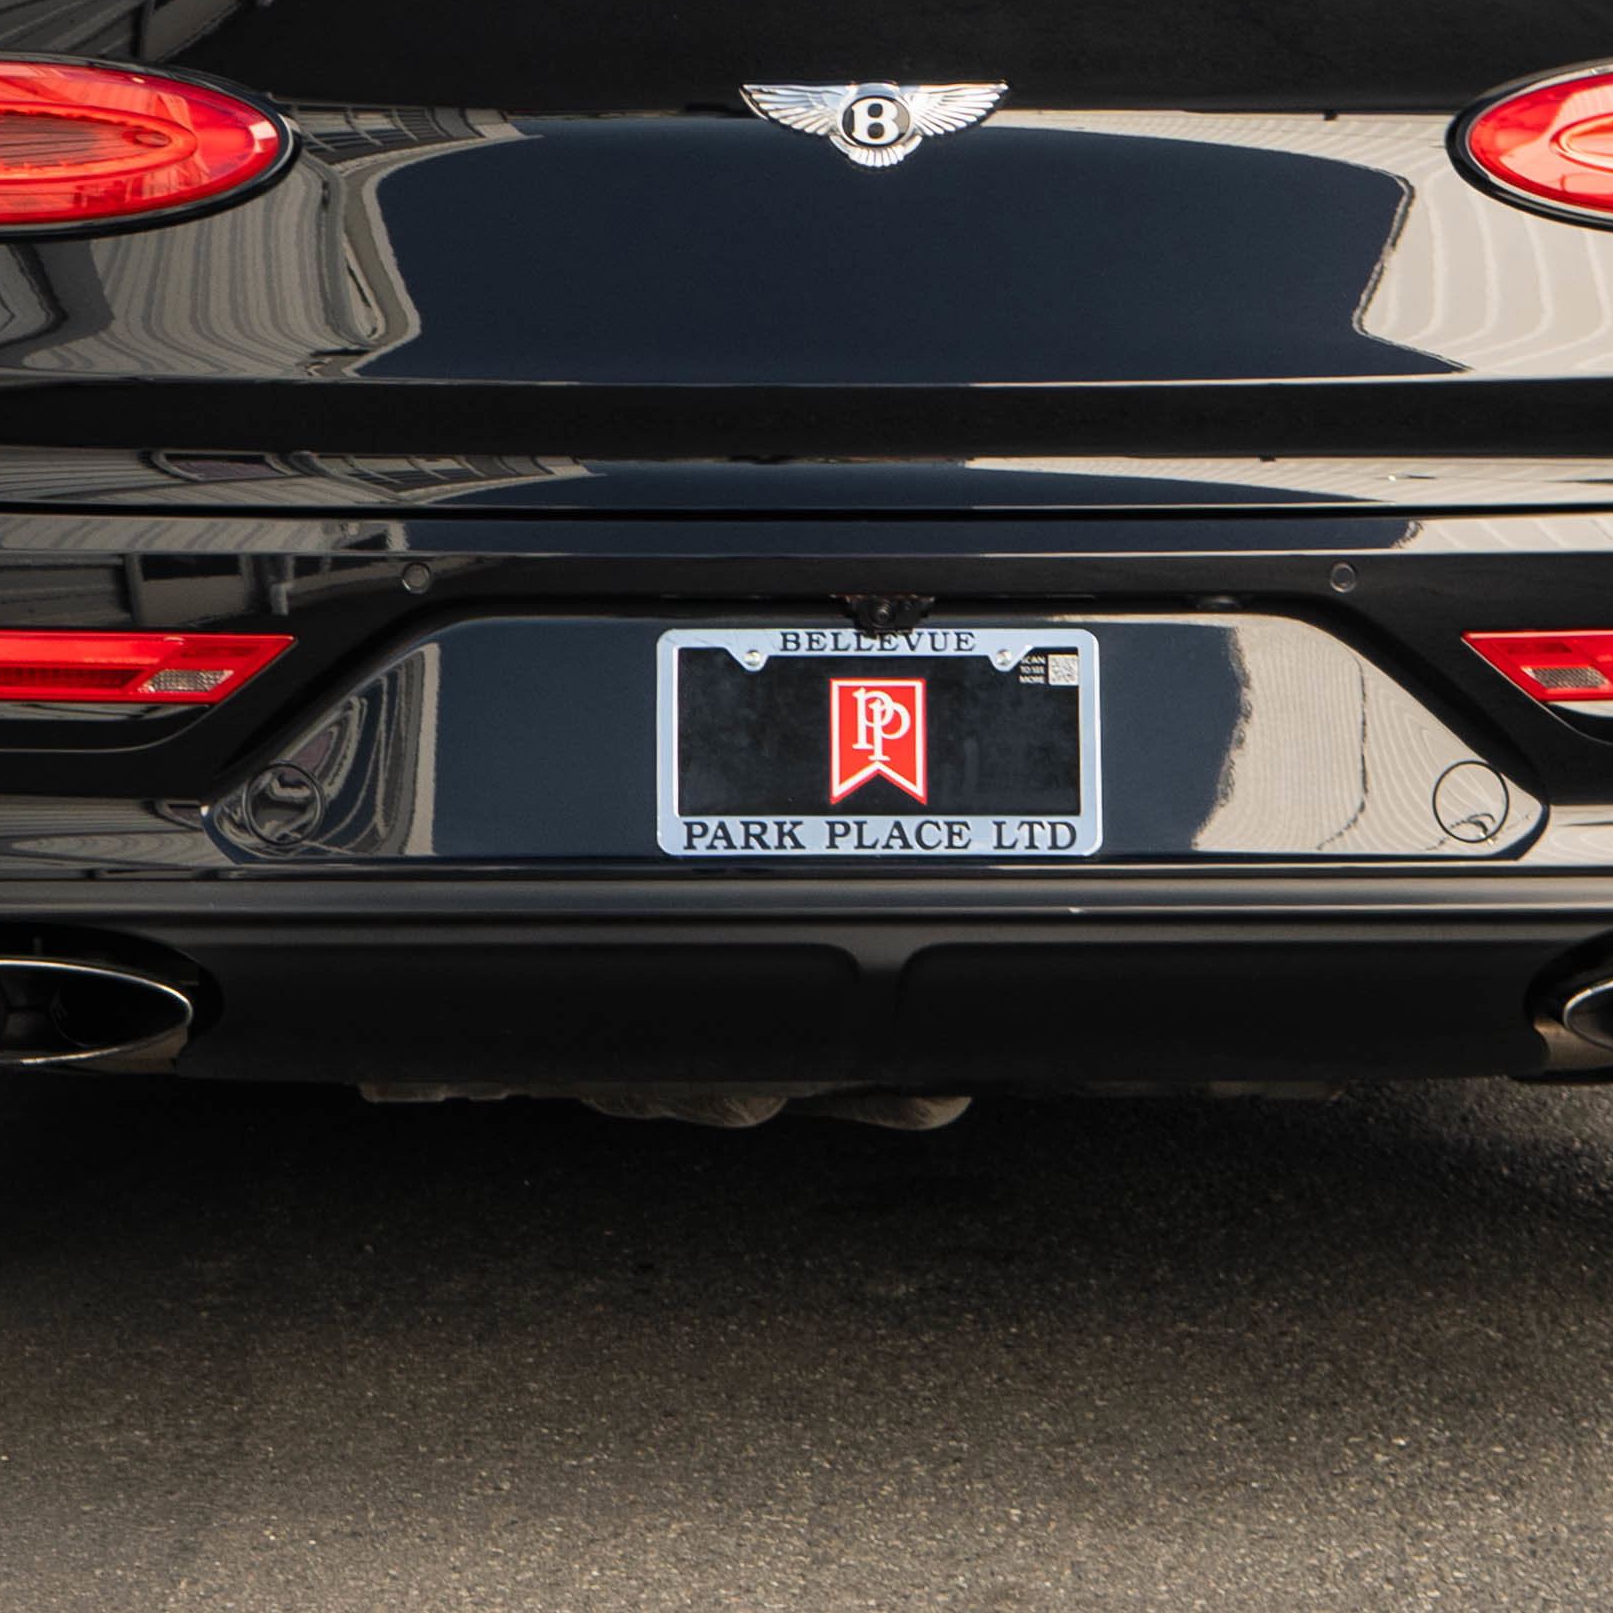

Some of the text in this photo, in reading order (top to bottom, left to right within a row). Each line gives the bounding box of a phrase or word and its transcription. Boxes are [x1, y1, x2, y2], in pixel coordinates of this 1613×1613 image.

[851, 97, 900, 145] B
[779, 630, 976, 652] BELLEVUE
[683, 819, 1077, 851] PARK PLACE LTD
